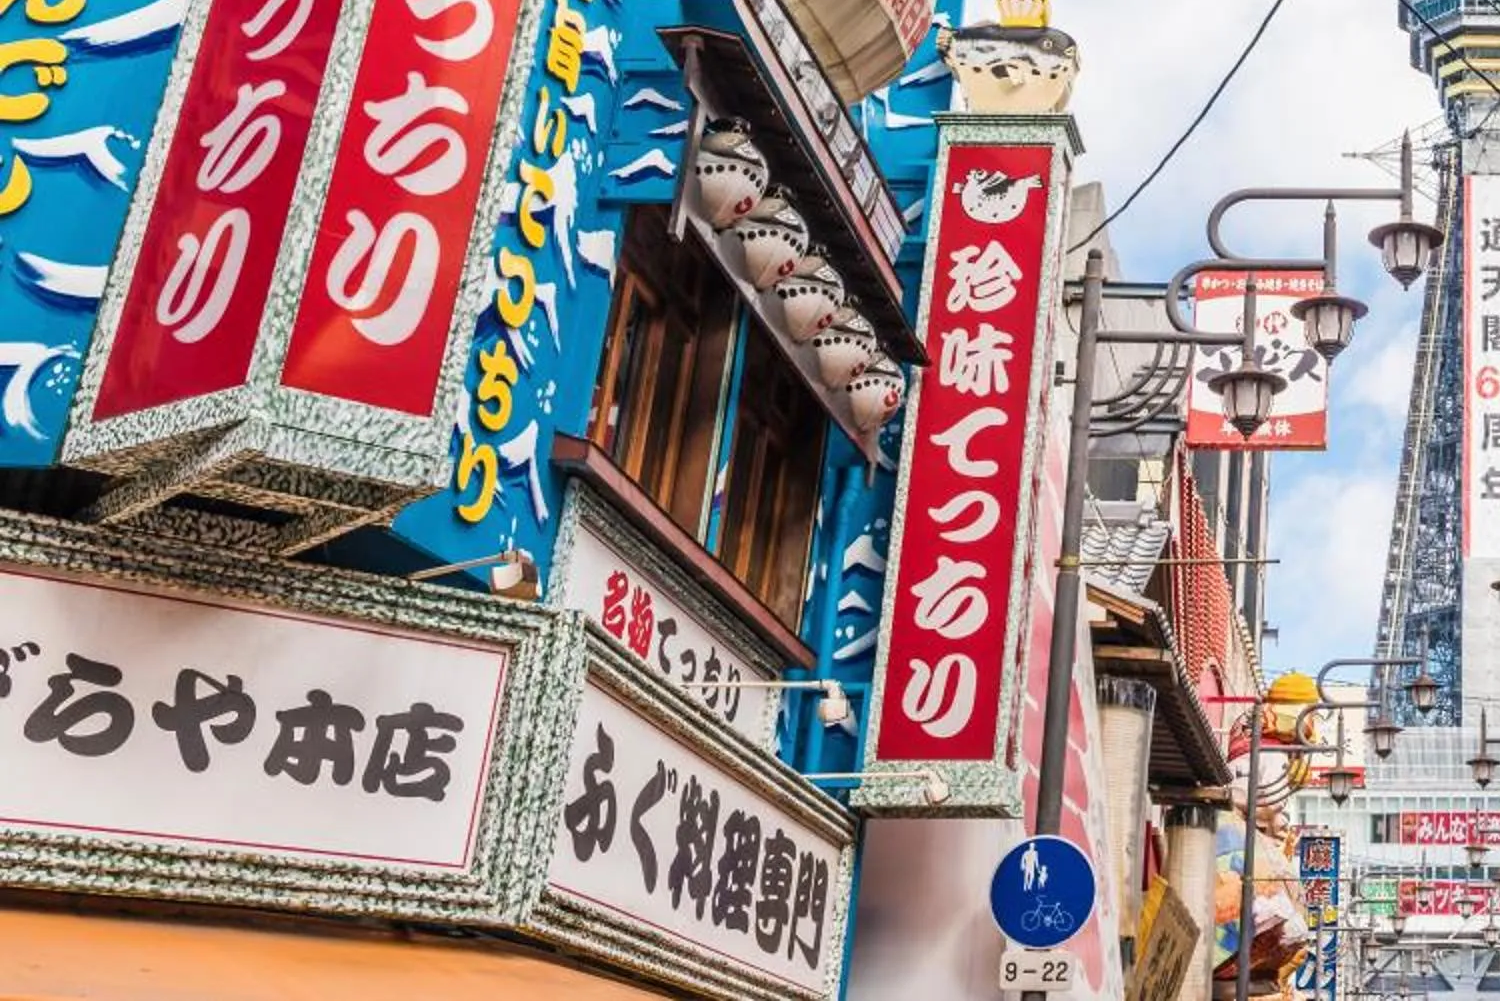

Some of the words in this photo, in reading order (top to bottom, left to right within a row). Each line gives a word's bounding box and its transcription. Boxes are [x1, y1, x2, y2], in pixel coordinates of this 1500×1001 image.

[1220, 420, 1293, 437] 年無休
[902, 240, 1023, 739] 珍味てっちり
[1005, 962, 1069, 982] 9-22
